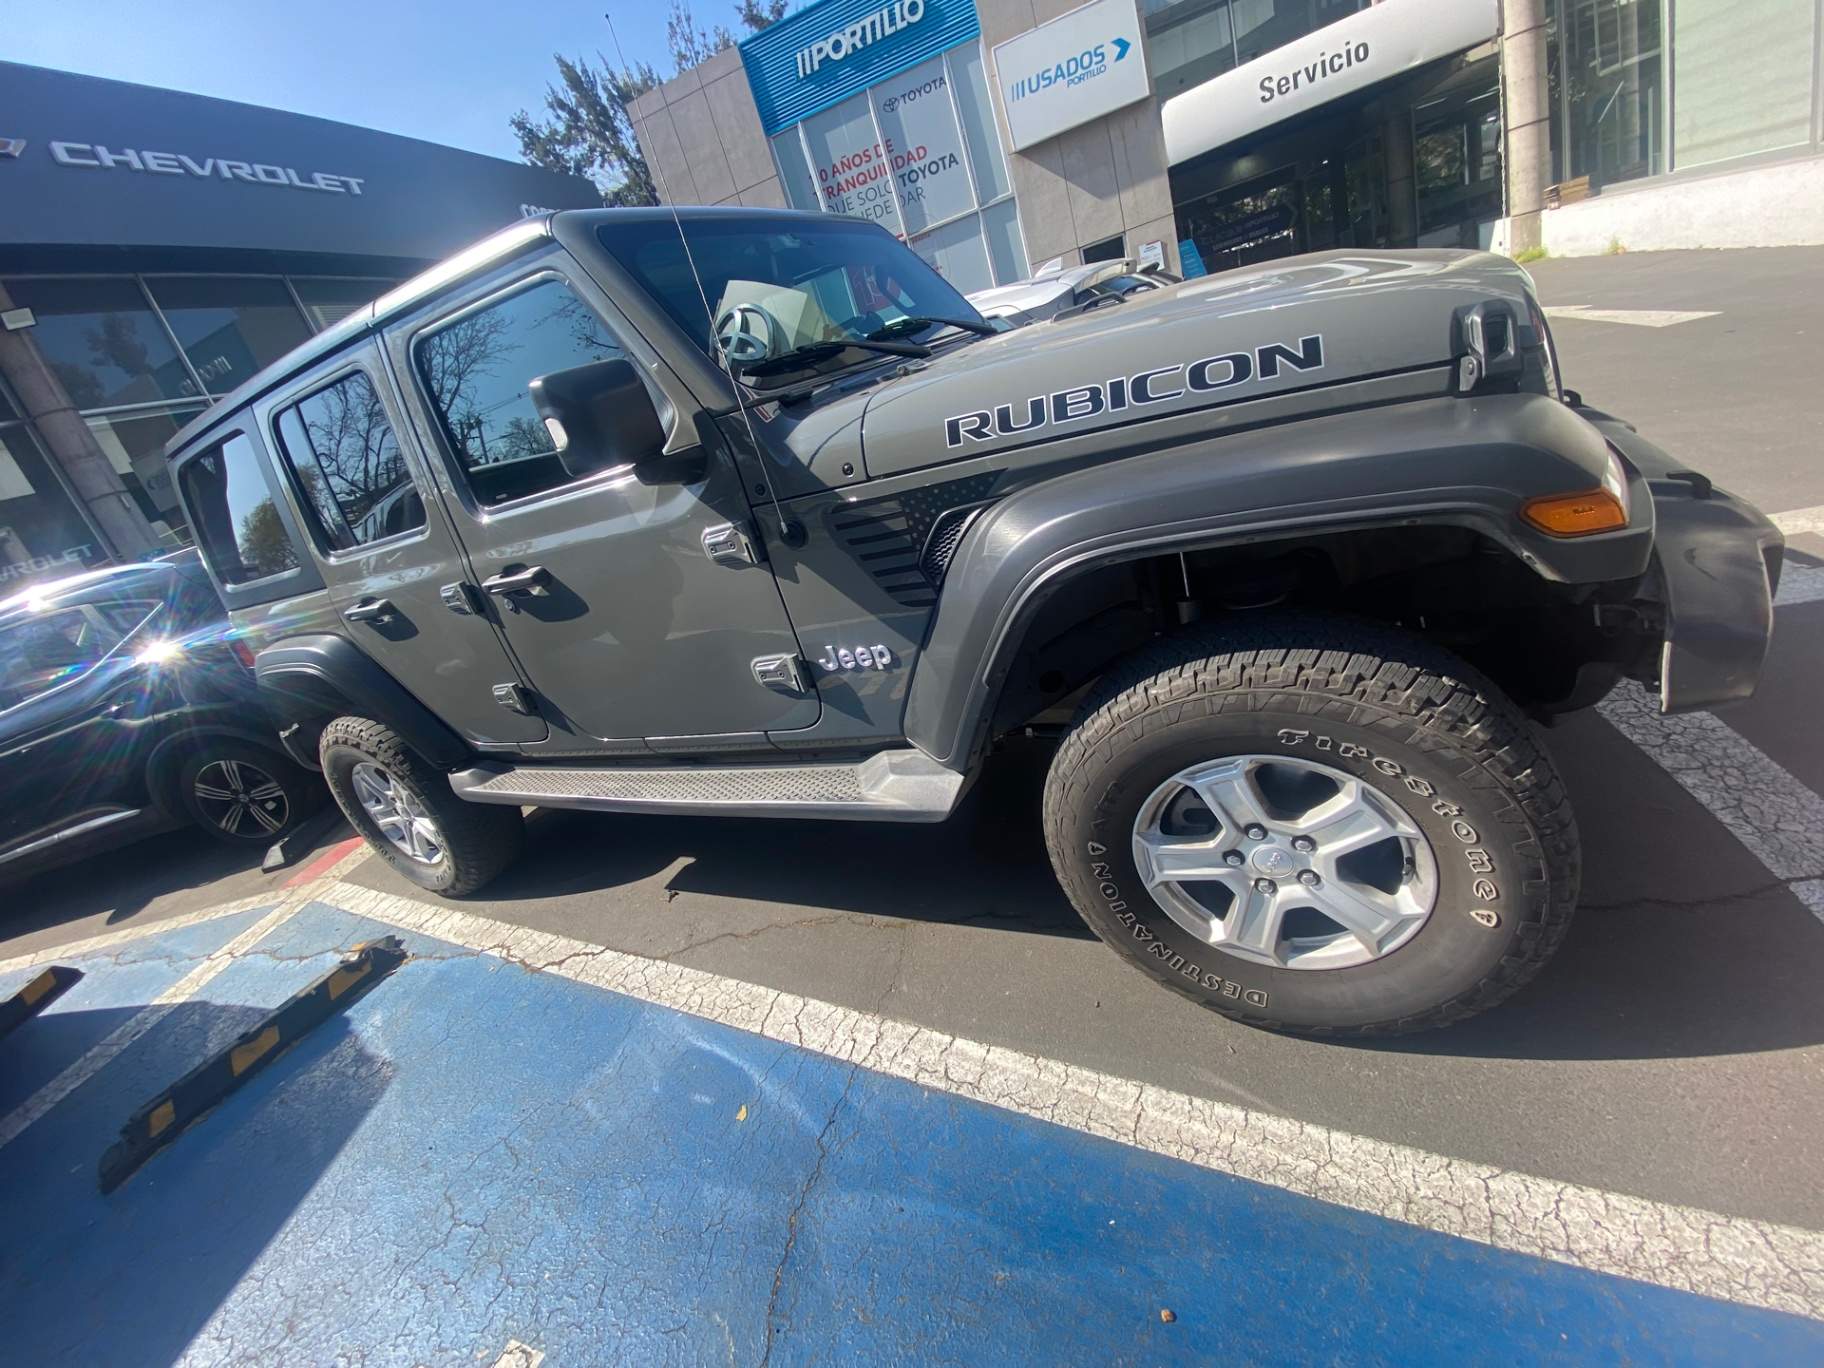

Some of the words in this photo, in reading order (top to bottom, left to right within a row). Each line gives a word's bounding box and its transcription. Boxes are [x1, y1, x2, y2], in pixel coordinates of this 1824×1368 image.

[810, 0, 925, 72] PORTILLO
[900, 76, 947, 105] TOYOTA
[1027, 44, 1106, 94] USADOS
[1066, 64, 1107, 88] PORTILLO
[1259, 40, 1370, 103] Servicio
[49, 140, 365, 196] CHEVROLET
[831, 148, 872, 178] AÑOS
[873, 139, 895, 159] DE
[857, 180, 893, 207] SOLO
[898, 152, 959, 188] TOYOTA
[944, 334, 1324, 448] RUBICON
[818, 644, 892, 672] Jeep
[1277, 727, 1498, 901] Firestone
[1092, 860, 1270, 1009] DESTINATION
